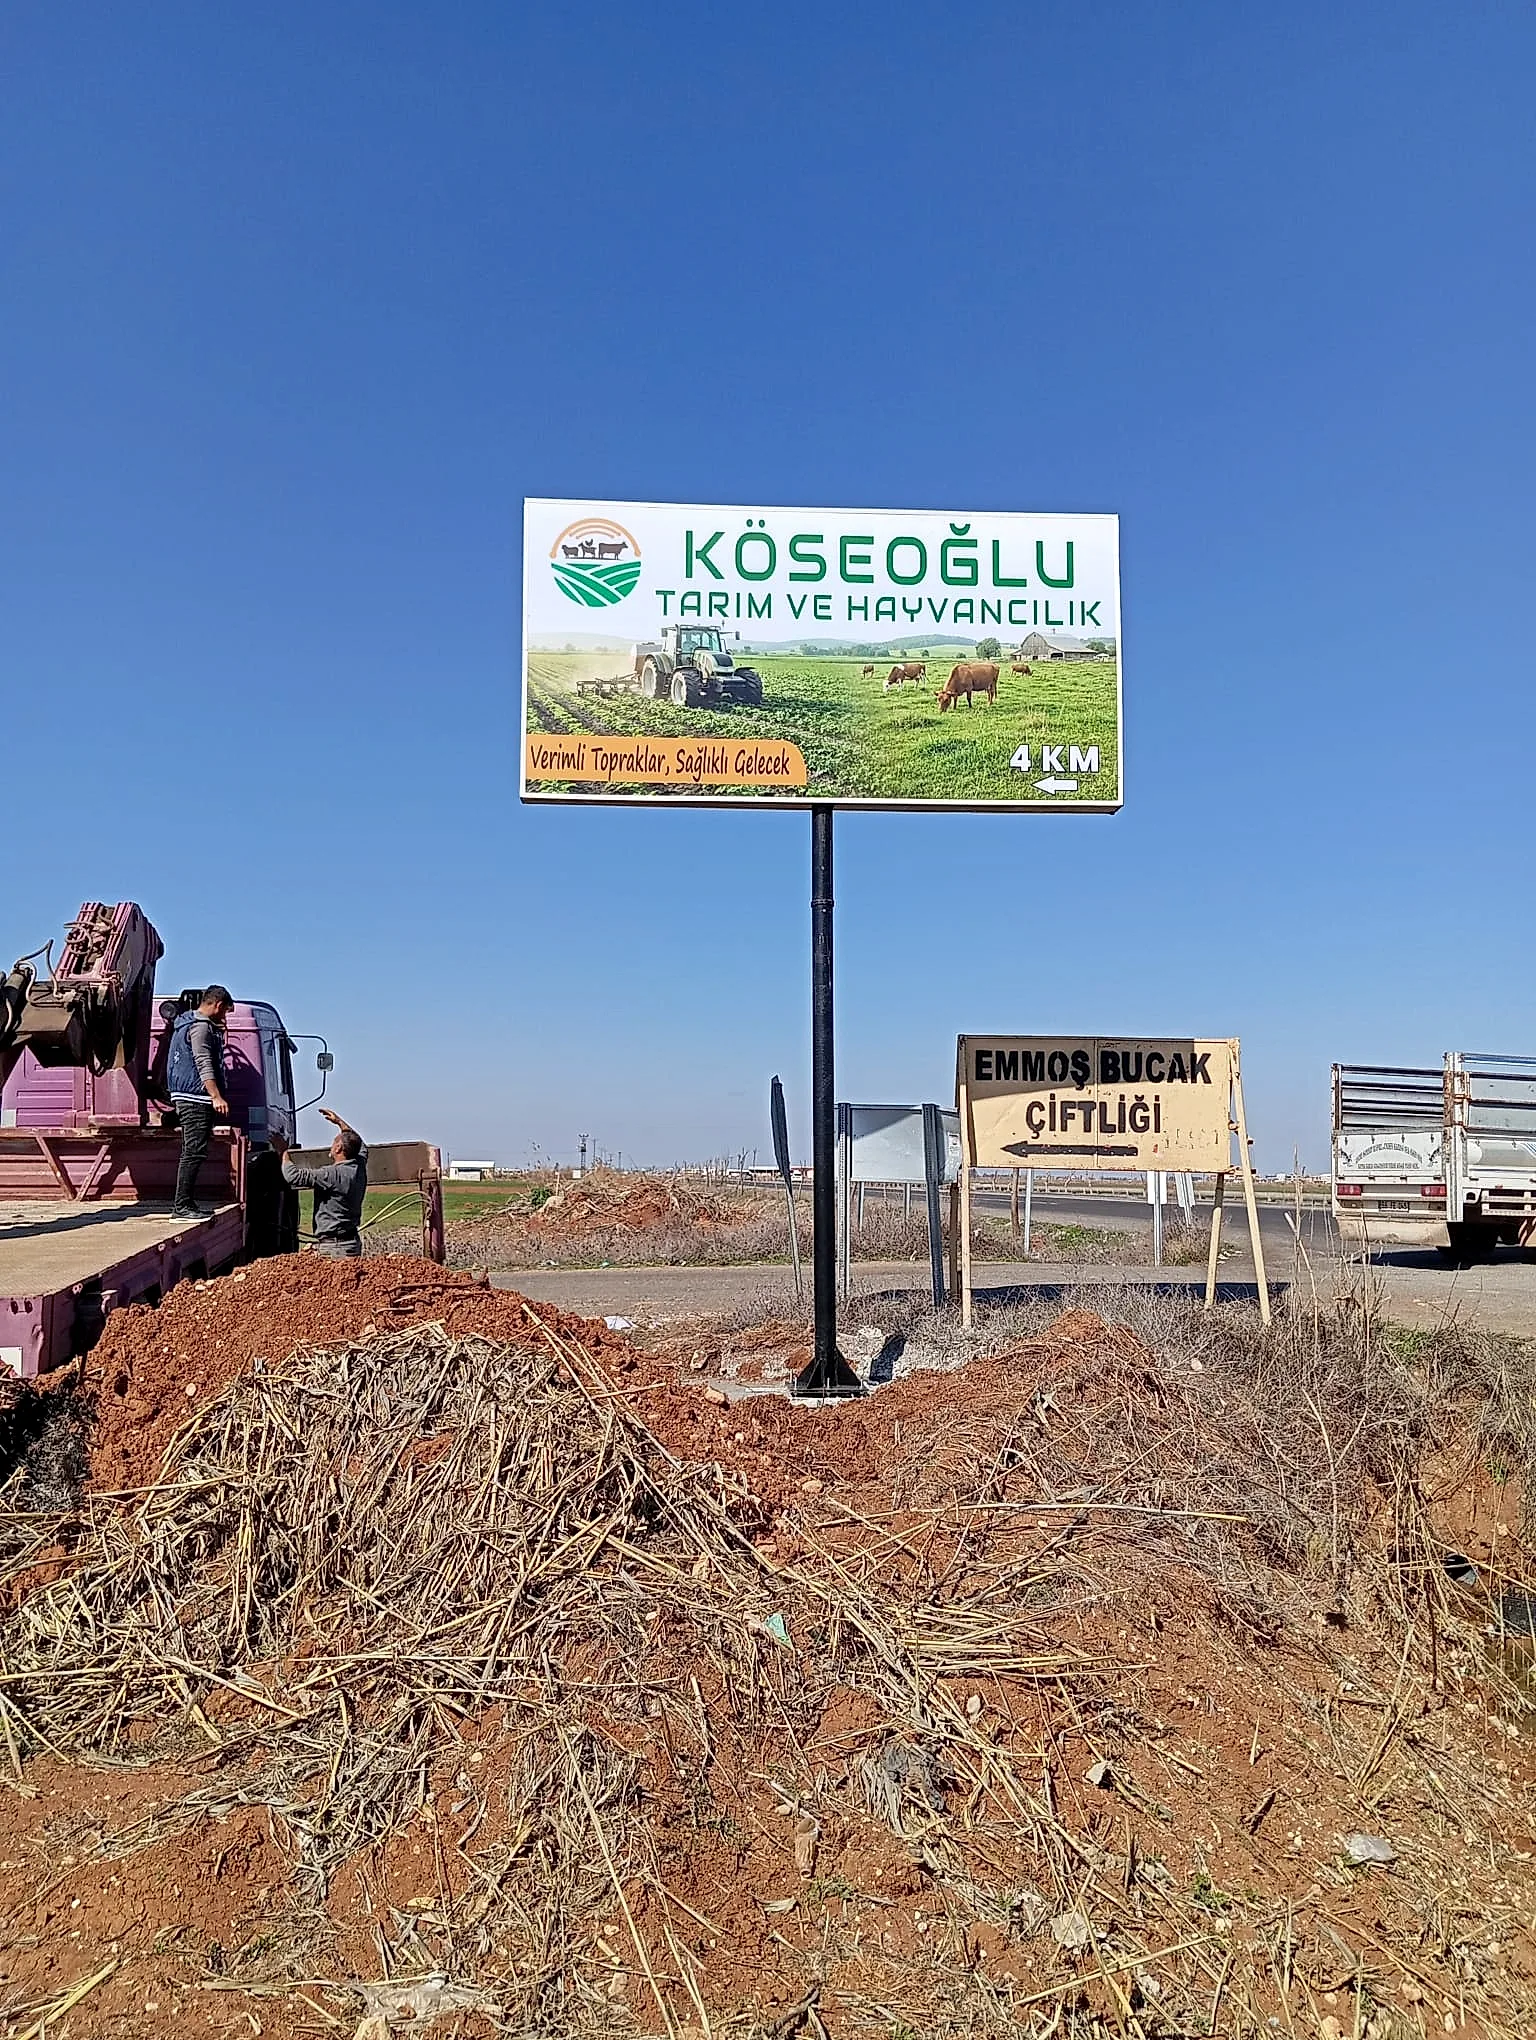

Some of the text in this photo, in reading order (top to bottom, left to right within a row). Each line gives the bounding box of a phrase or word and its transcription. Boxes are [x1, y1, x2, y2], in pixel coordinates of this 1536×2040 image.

[685, 519, 1074, 589] KÖSEOĞLU
[655, 590, 1101, 626] TARIM VE HAYVANCILIK
[530, 743, 790, 782] Verimli Topraklar, Sağlıklı Gelecek
[1009, 744, 1100, 773] 4 KM
[975, 1050, 1212, 1090] EMMOŞ BUCAK
[1025, 1093, 1161, 1139] ÇİFTLİĞİ
